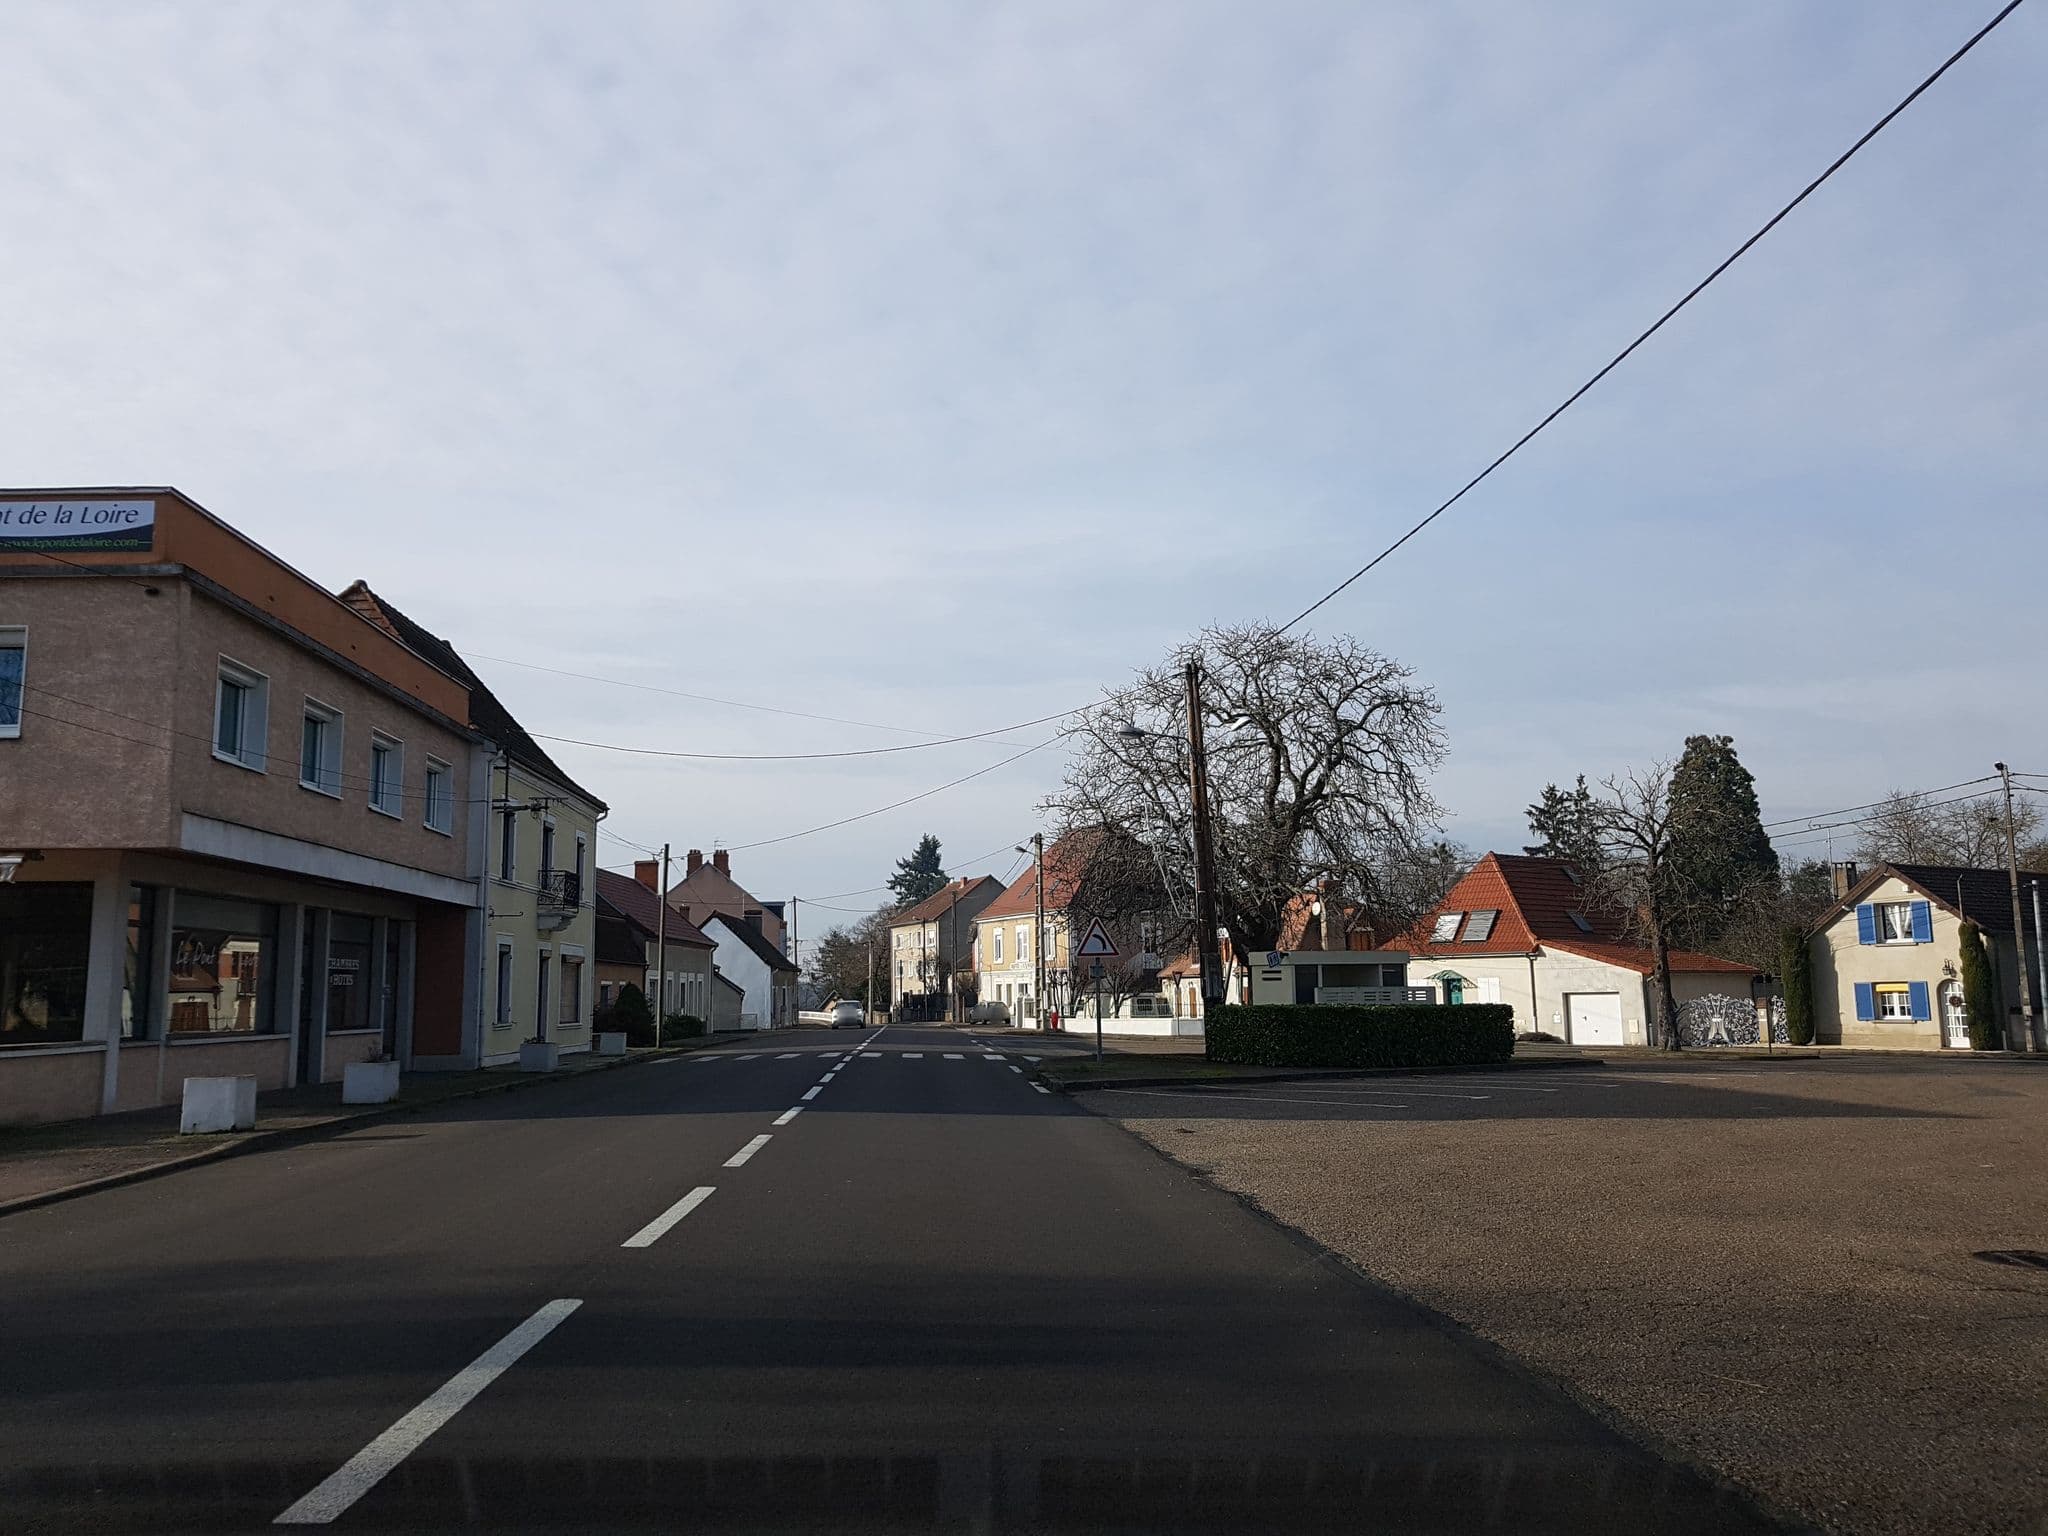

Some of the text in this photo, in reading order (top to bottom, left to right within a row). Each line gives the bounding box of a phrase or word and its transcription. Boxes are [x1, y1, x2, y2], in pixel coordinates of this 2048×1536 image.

[18, 504, 47, 524] de
[53, 504, 73, 524] la
[80, 503, 139, 524] Loire
